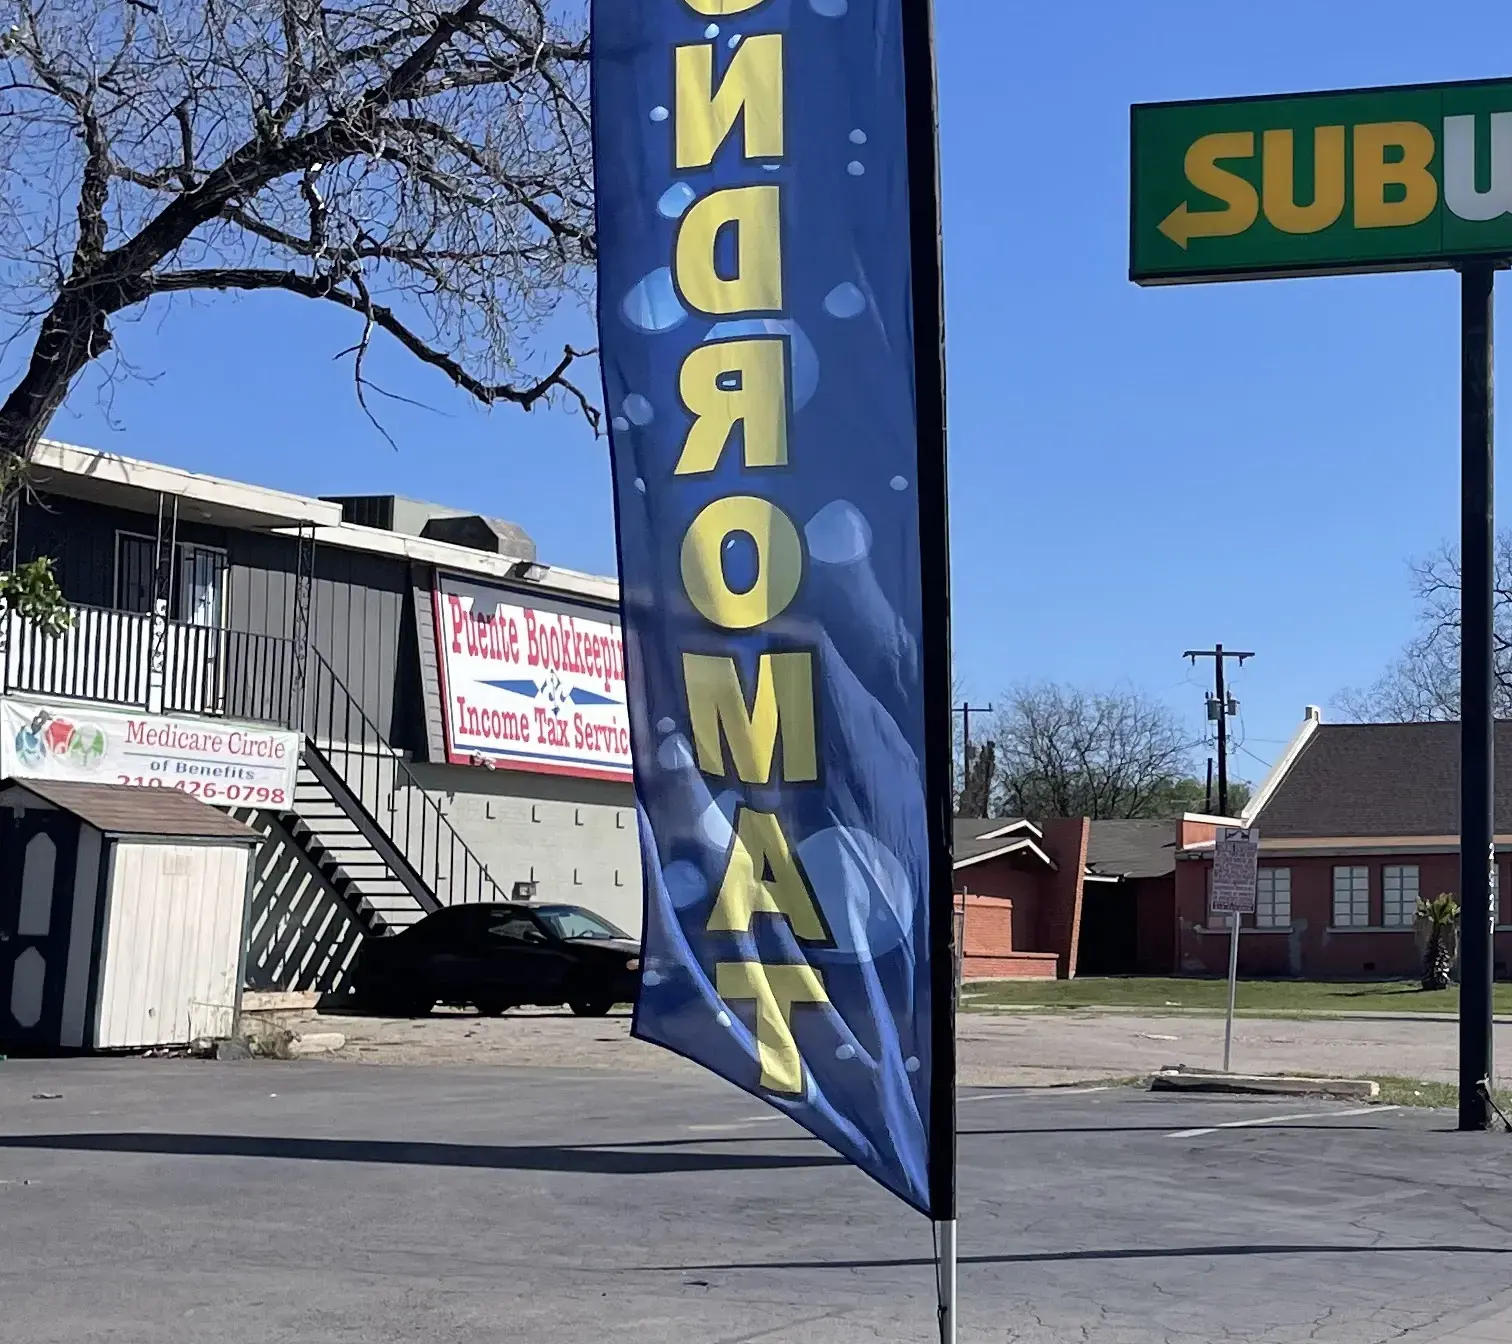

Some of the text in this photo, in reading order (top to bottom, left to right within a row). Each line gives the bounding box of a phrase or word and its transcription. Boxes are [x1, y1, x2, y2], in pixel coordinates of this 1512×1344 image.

[448, 593, 624, 692] Puente Bookkeepin
[124, 719, 285, 760] Medicare Circle
[457, 696, 629, 755] Income Tax Servic
[116, 774, 285, 804] 210426-0798
[150, 760, 256, 780] of Benefits
